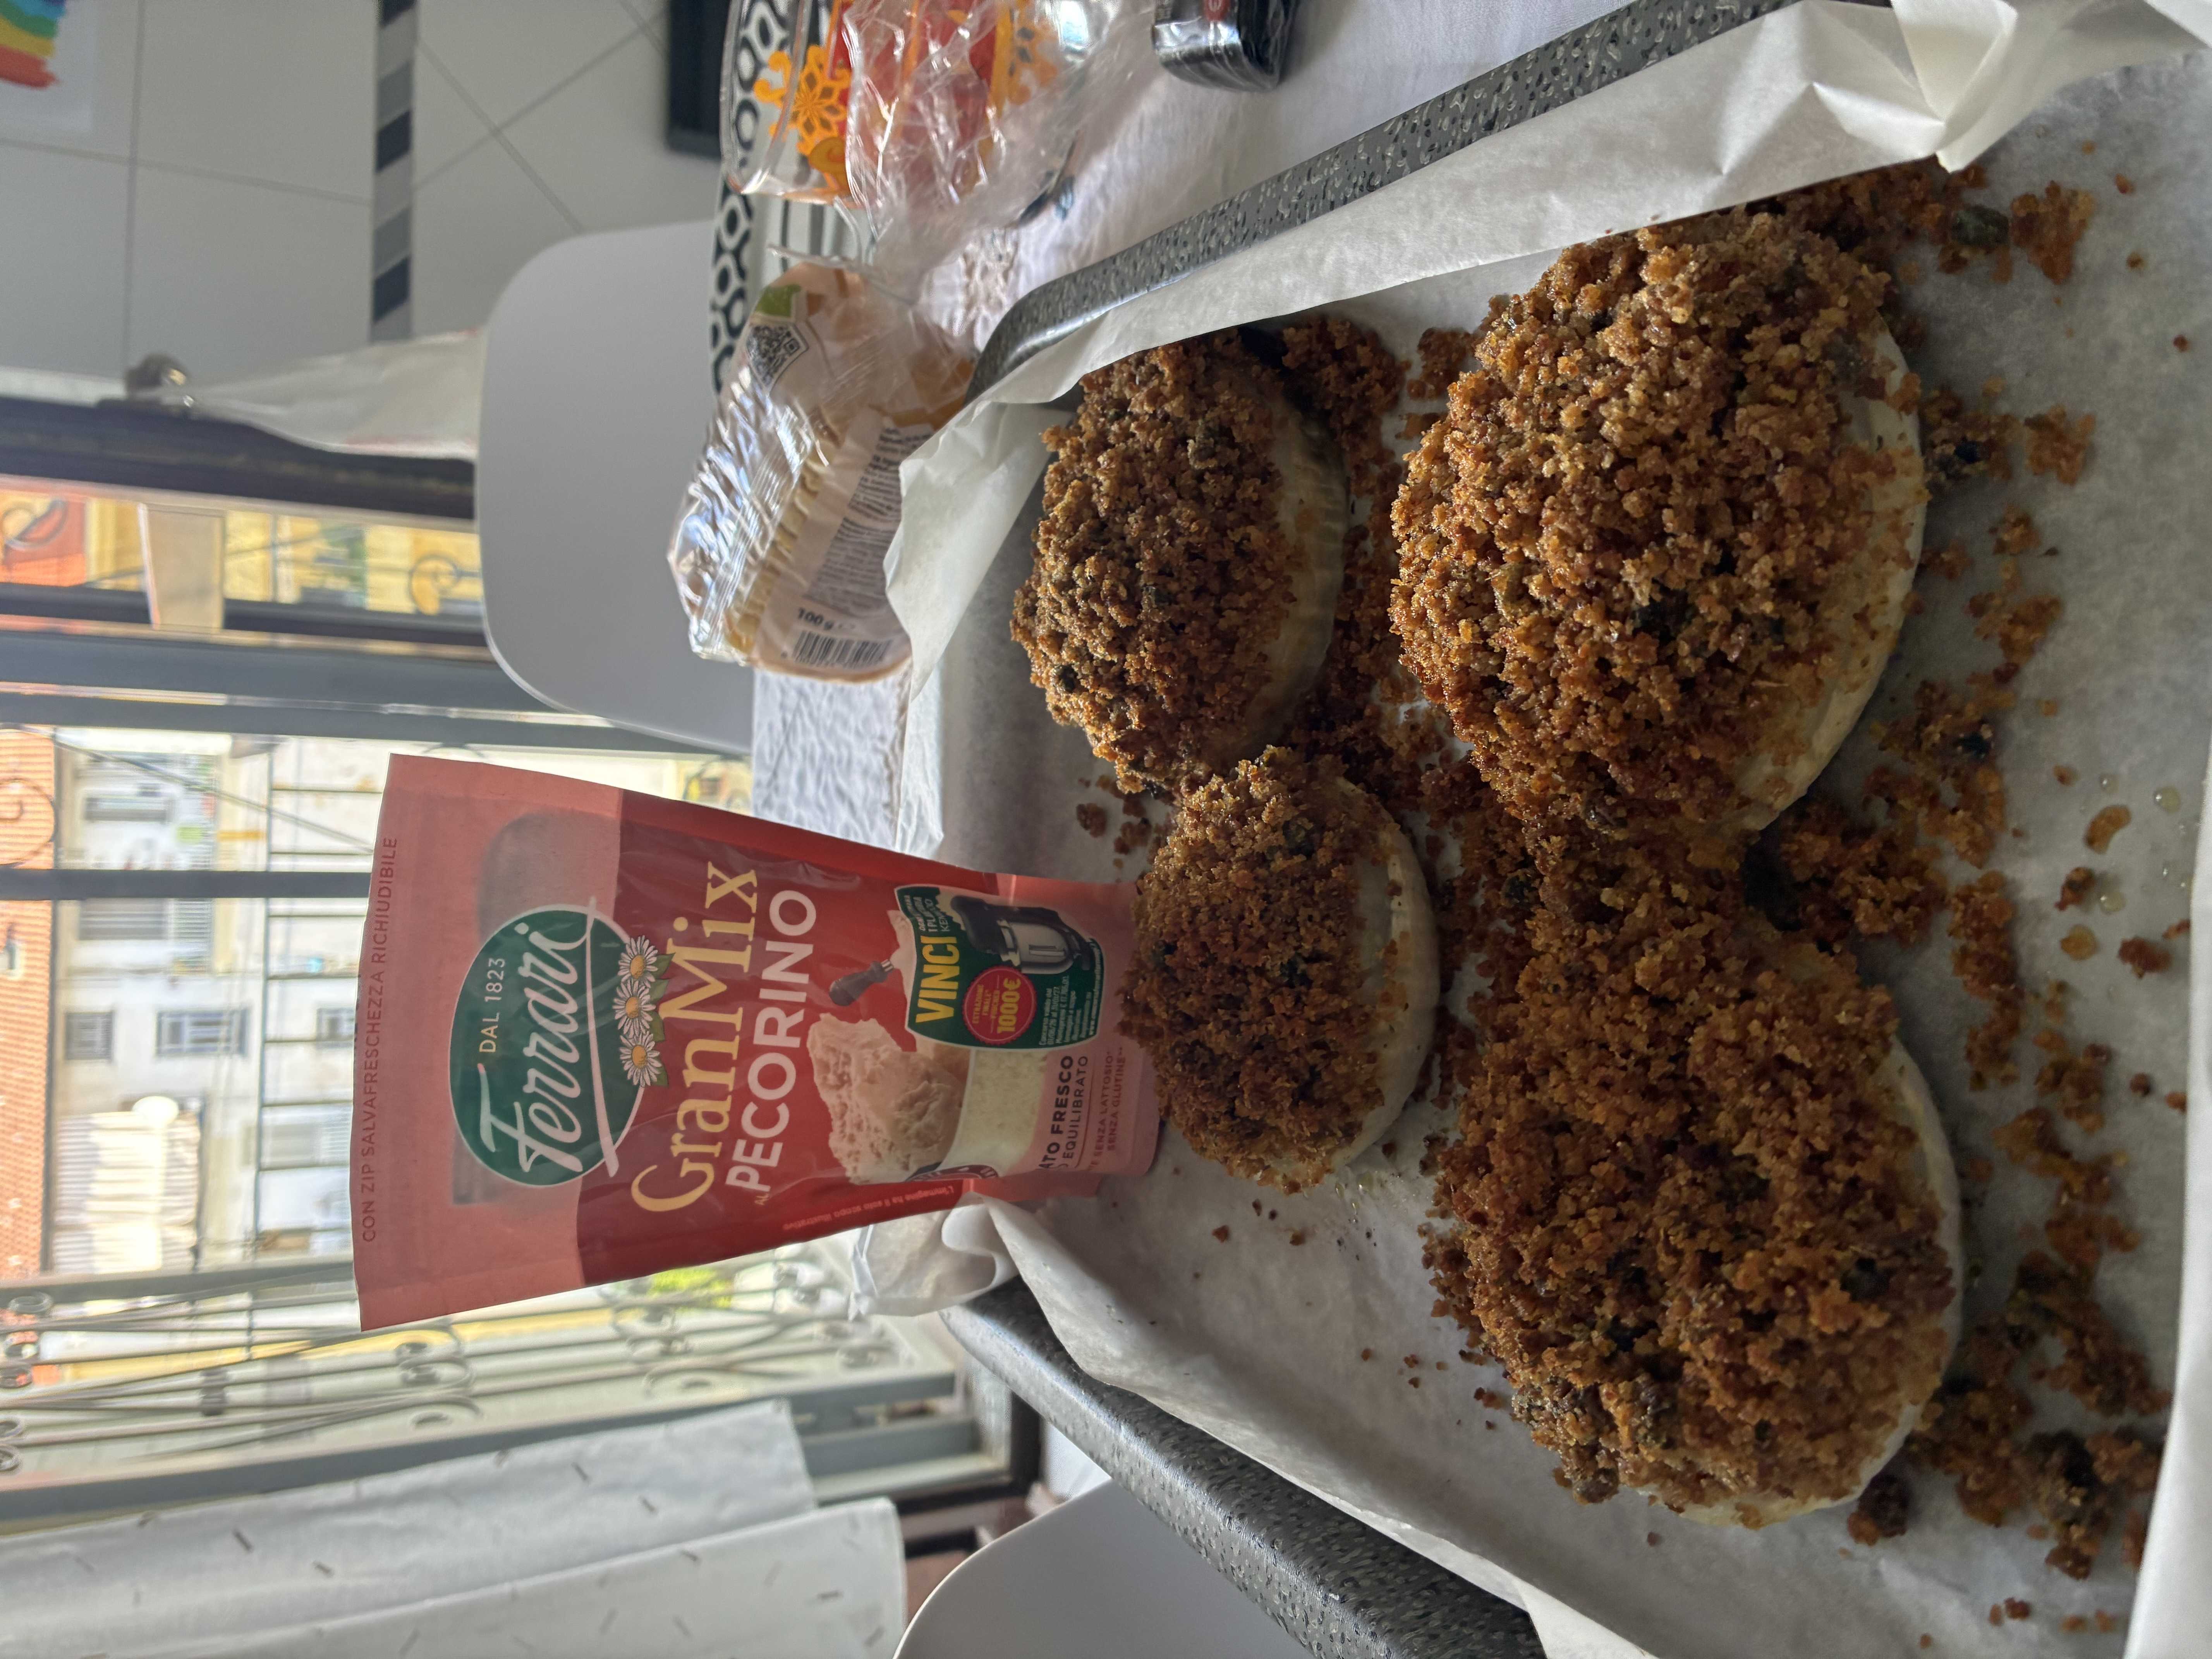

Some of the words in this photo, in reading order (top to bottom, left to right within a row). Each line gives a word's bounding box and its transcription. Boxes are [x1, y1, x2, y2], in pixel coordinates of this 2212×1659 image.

[798, 607, 824, 625] 100
[371, 838, 397, 963] RICHIUDIBILE
[484, 958, 505, 1002] 1823
[915, 936, 960, 1023] VINCI
[972, 984, 984, 1024] ESTRAZIONE
[997, 978, 1022, 1034] 1000€
[476, 922, 587, 1173] Ferrari
[479, 1013, 499, 1053] DAL
[631, 861, 758, 1212] GranMix
[725, 890, 817, 1192] PECORINO
[1039, 1018, 1049, 1045] Concorso
[362, 971, 384, 1156] SALVAFRESCHEZZA
[1050, 1056, 1073, 1135] FRESCO
[1062, 1056, 1088, 1159] EQUILIBRATO
[1093, 1118, 1106, 1156] SENZA
[1107, 1111, 1119, 1151] SENZA
[361, 1164, 374, 1193] ZIP
[362, 1201, 376, 1242] CON
